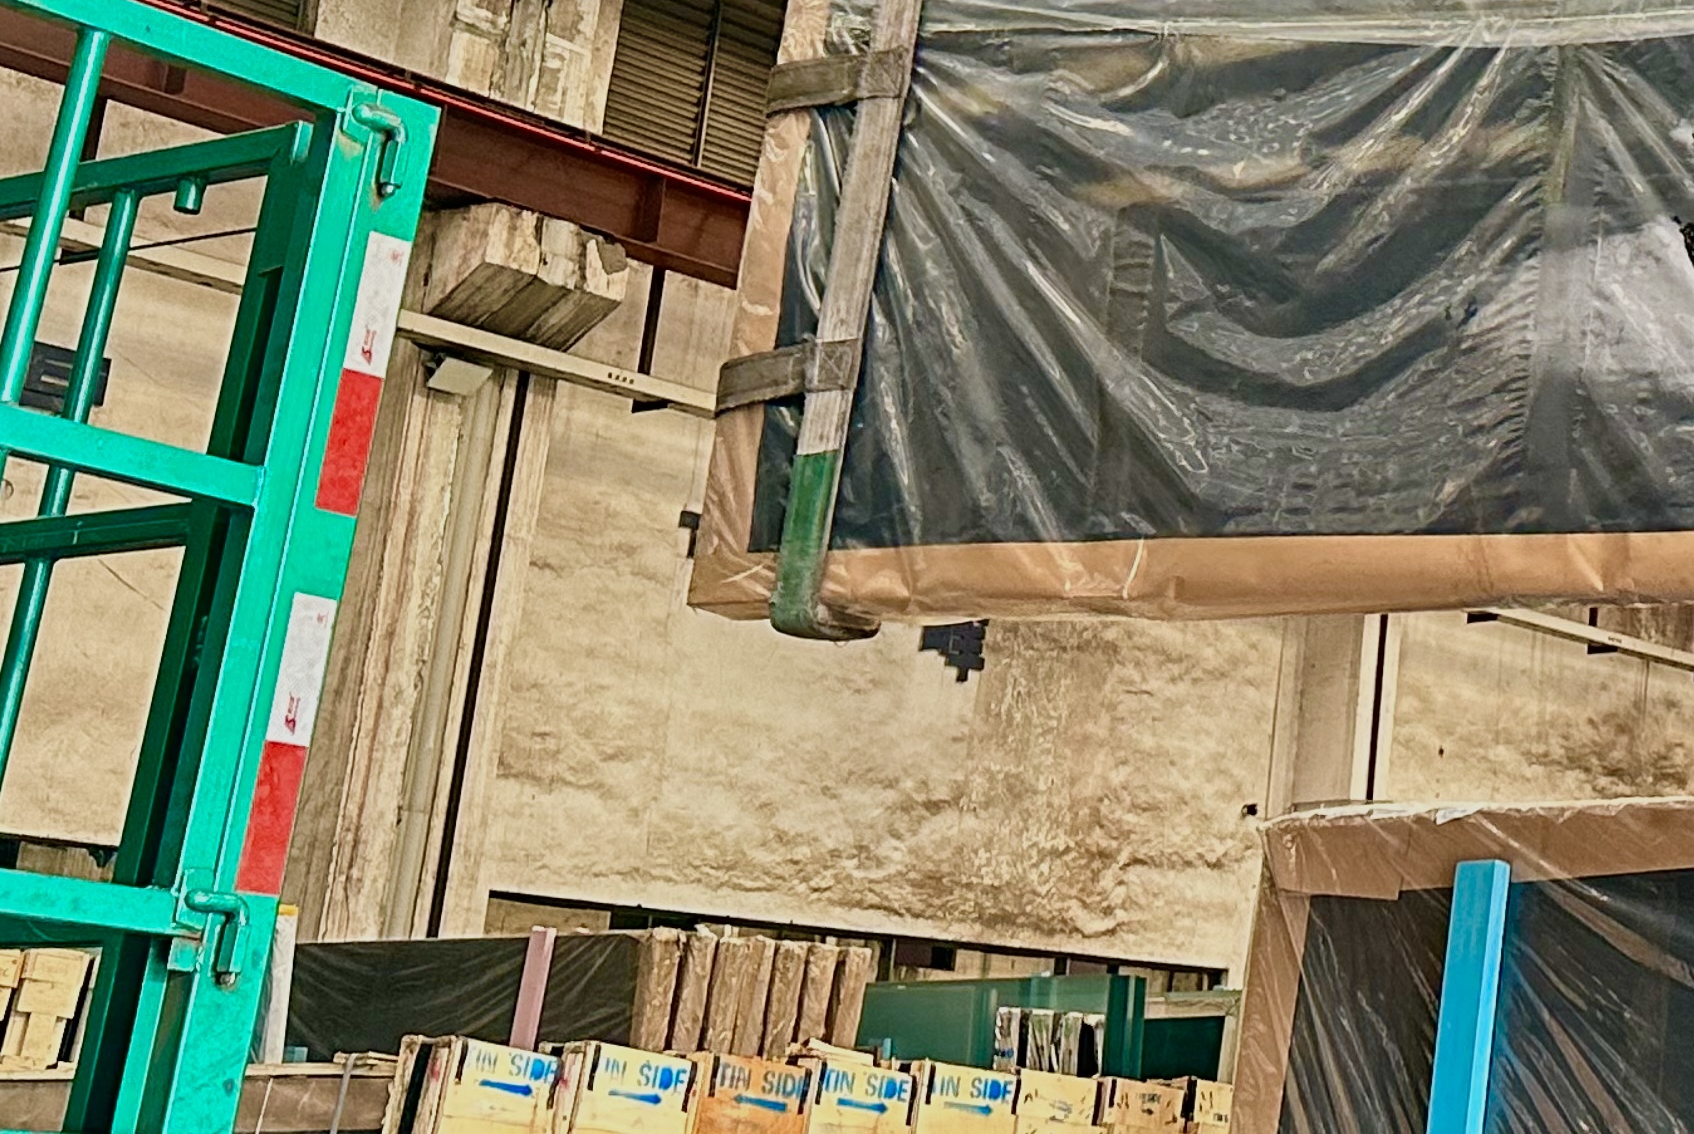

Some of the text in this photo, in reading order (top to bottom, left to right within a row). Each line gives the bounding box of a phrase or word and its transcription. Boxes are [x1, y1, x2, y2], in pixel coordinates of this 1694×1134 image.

[824, 1068, 909, 1102] TIN SIDE
[932, 1075, 960, 1097] IN
